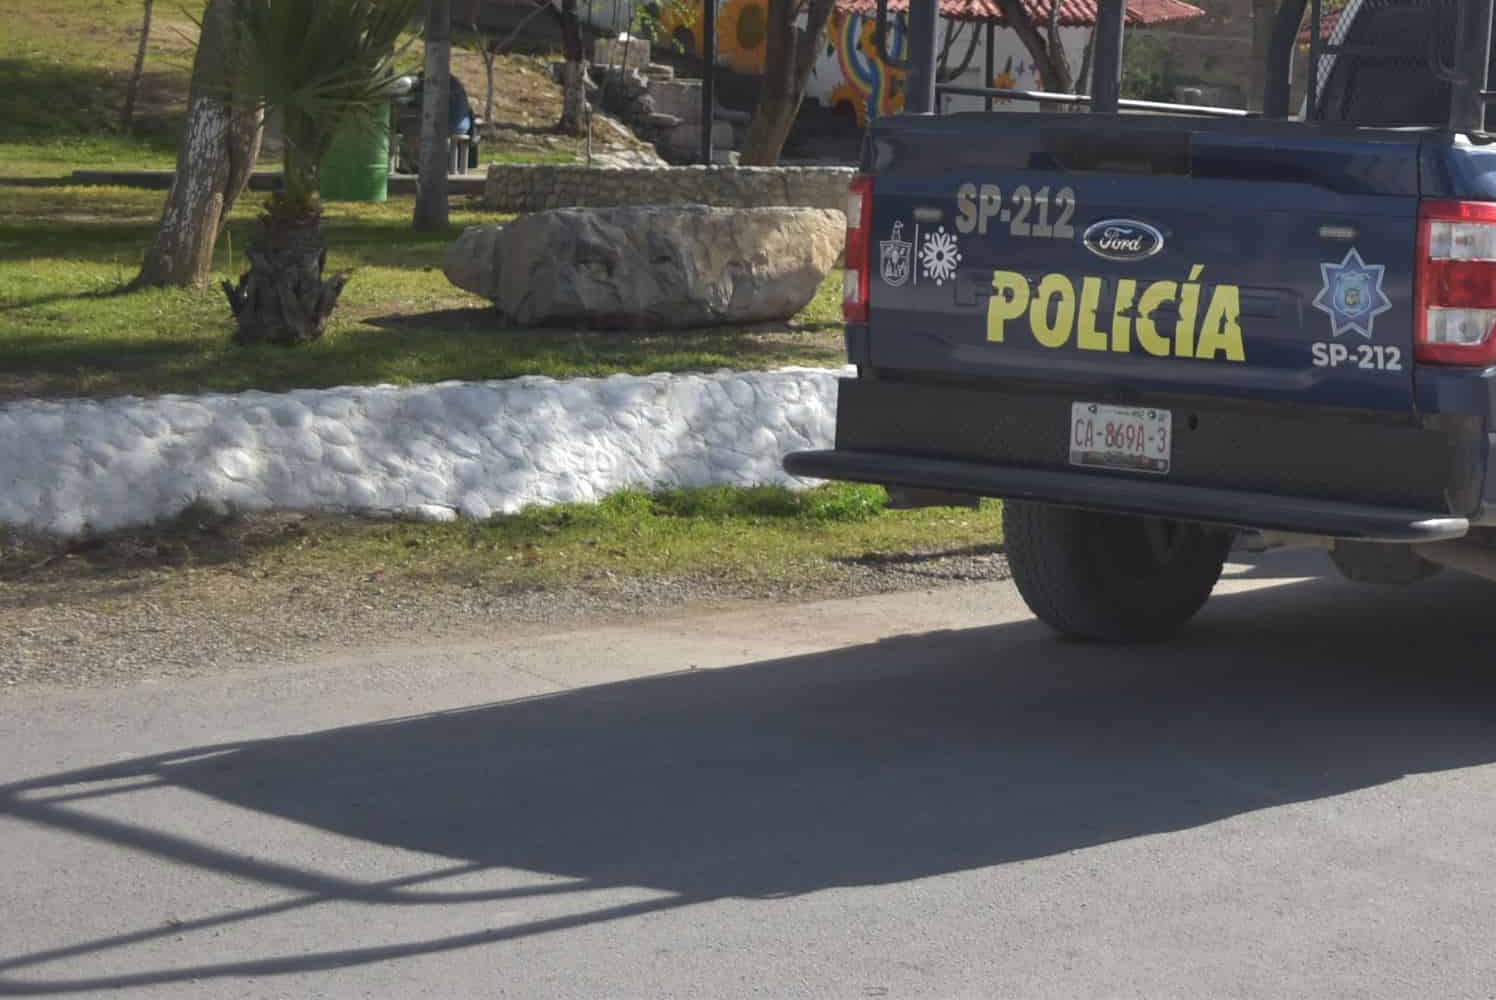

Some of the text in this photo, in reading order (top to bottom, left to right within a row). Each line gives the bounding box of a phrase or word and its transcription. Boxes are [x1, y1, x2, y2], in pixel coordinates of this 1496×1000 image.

[955, 183, 1076, 239] SP-212
[1099, 226, 1142, 251] Ford
[986, 264, 1246, 361] POLICÍA
[1312, 342, 1402, 371] SP-212
[1075, 418, 1167, 454] CA-869A-3
